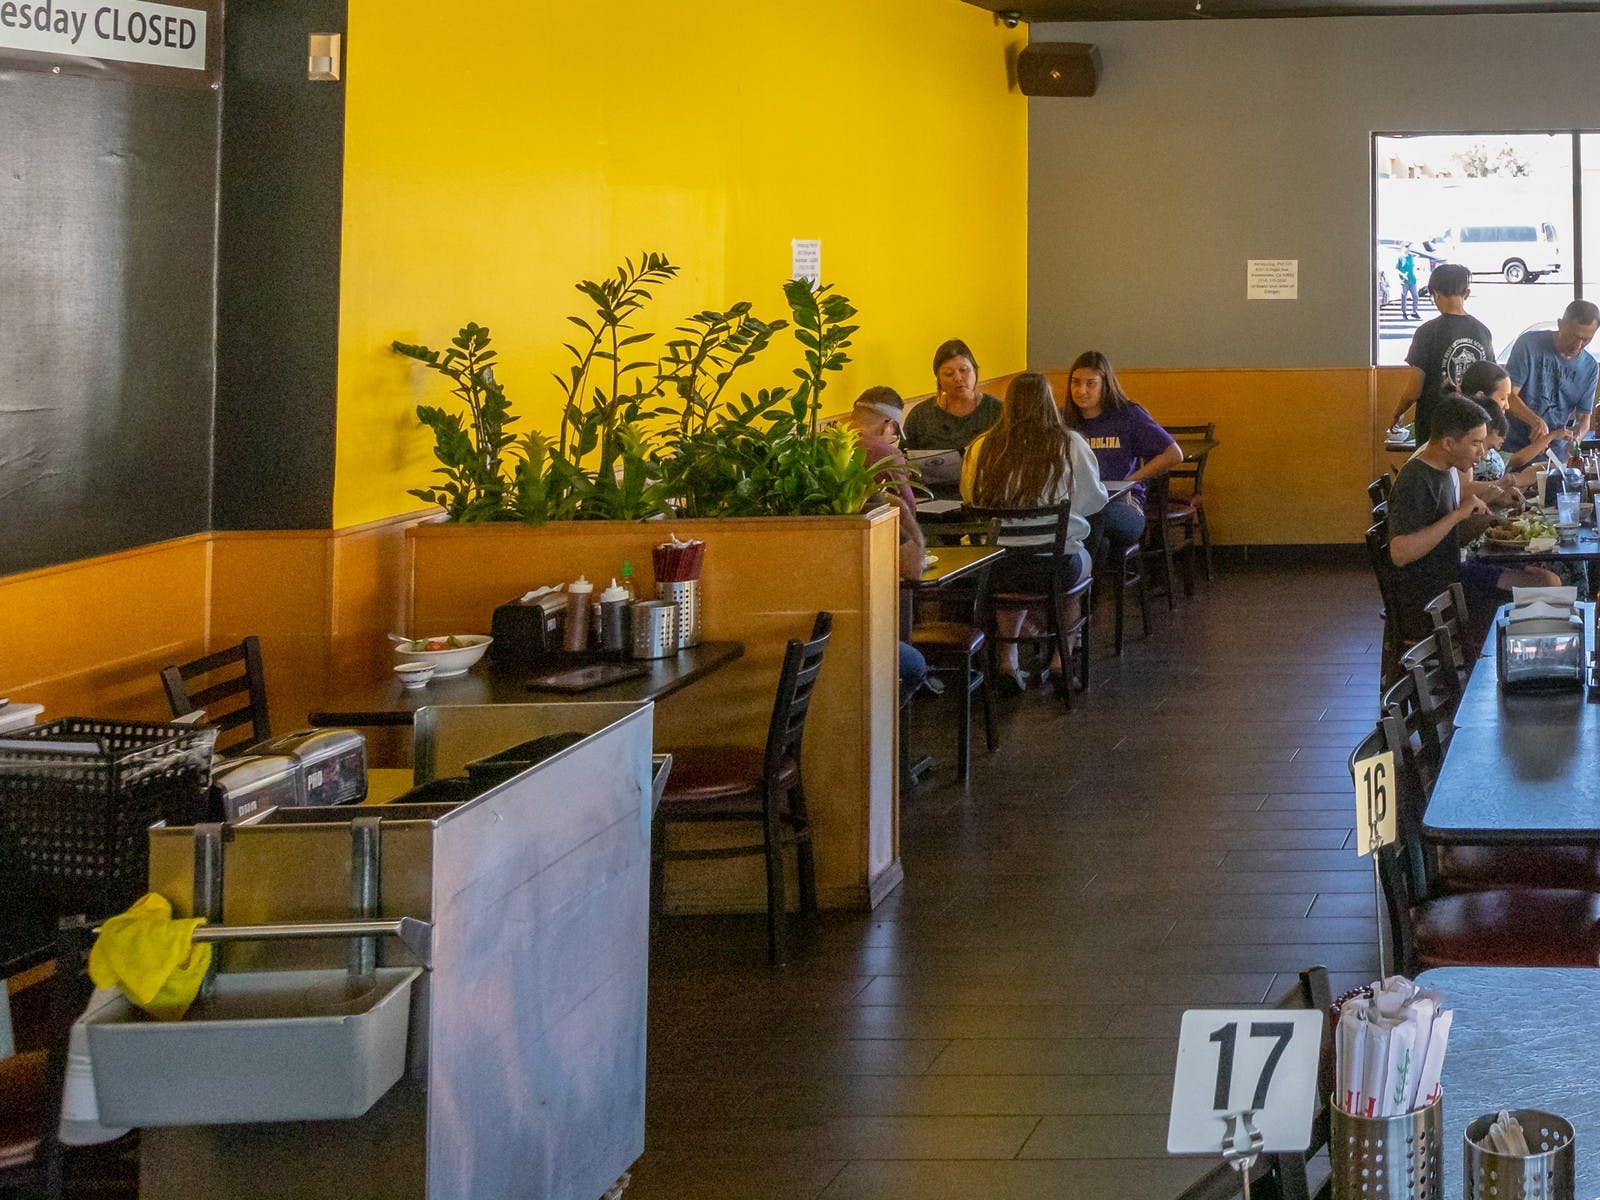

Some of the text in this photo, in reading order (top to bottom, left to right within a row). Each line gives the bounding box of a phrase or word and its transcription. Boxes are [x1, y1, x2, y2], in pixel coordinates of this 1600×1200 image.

[95, 7, 196, 49] CLOSED
[1363, 762, 1386, 826] 16
[1209, 1022, 1294, 1110] 17
